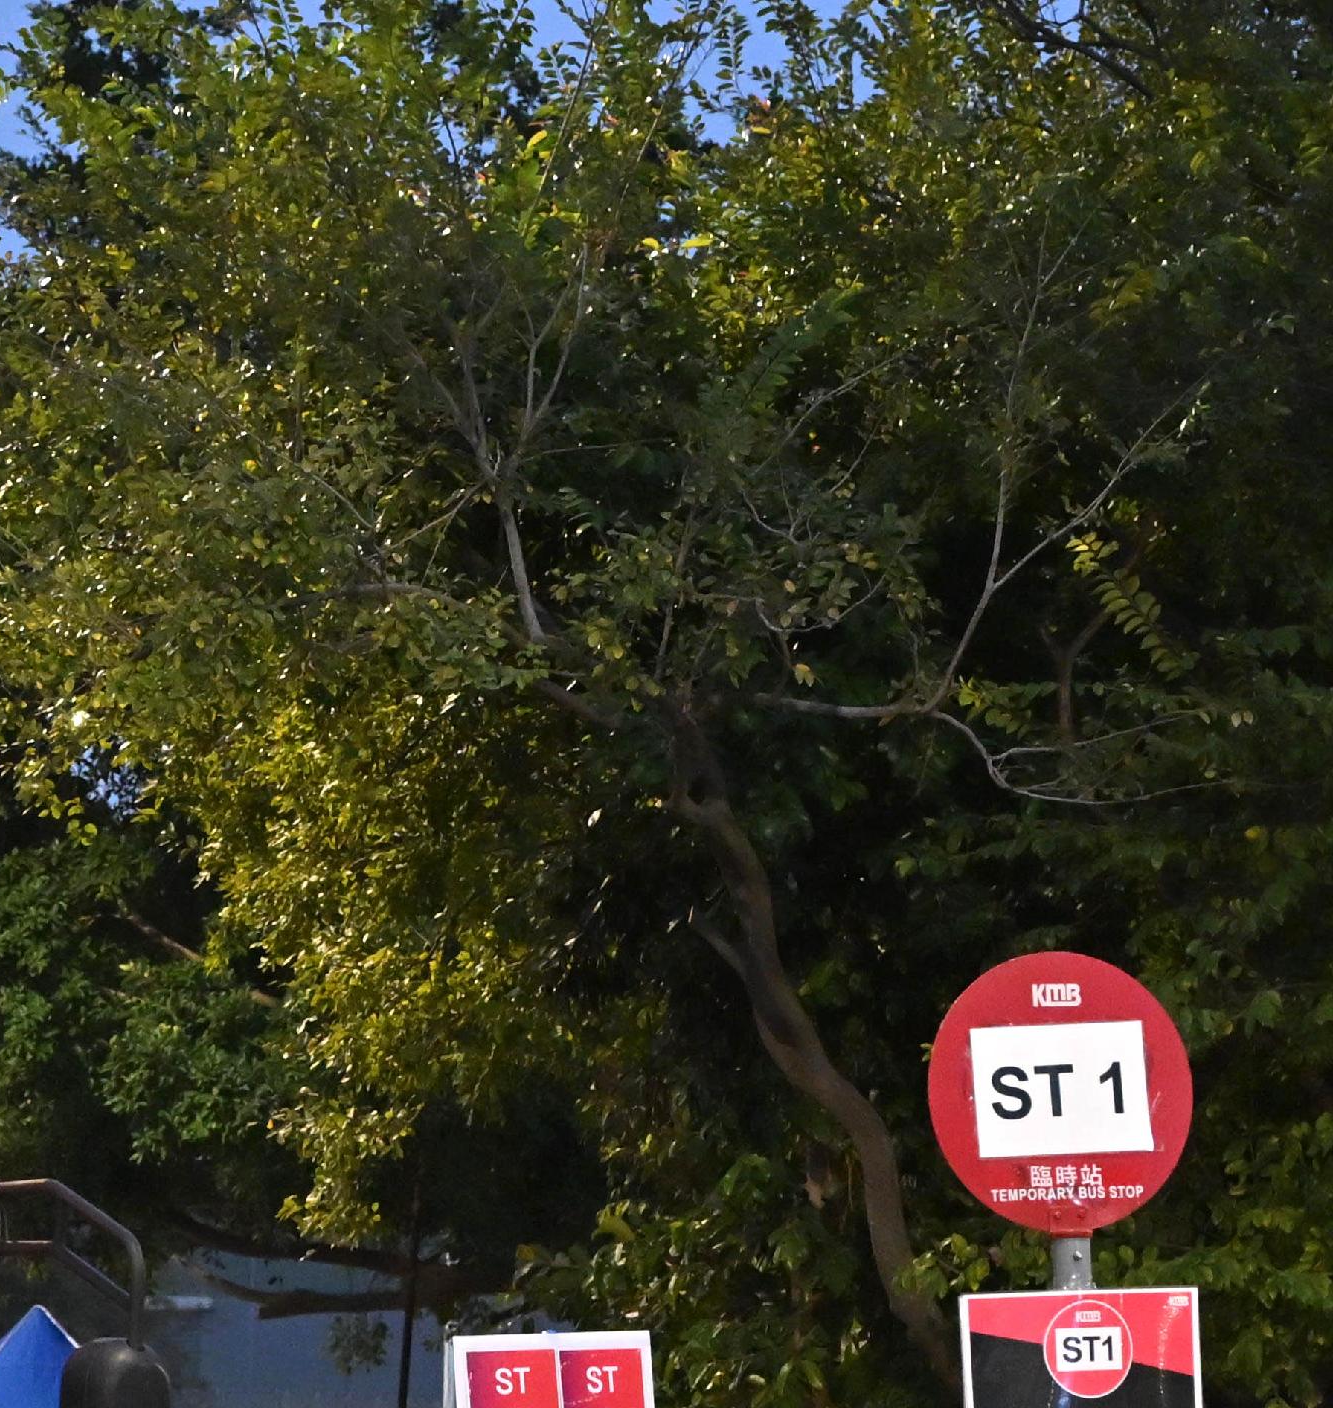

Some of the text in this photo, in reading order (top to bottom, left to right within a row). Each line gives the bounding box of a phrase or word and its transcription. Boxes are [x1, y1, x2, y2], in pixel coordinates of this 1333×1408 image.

[1031, 982, 1083, 1008] KMB
[990, 1060, 1125, 1121] ST 1
[1029, 1163, 1104, 1188] 臨時站
[990, 1185, 1144, 1203] TEMPORARY BUS STOP
[1062, 1335, 1115, 1363] ST1
[494, 1366, 531, 1396] ST
[585, 1365, 619, 1393] ST
